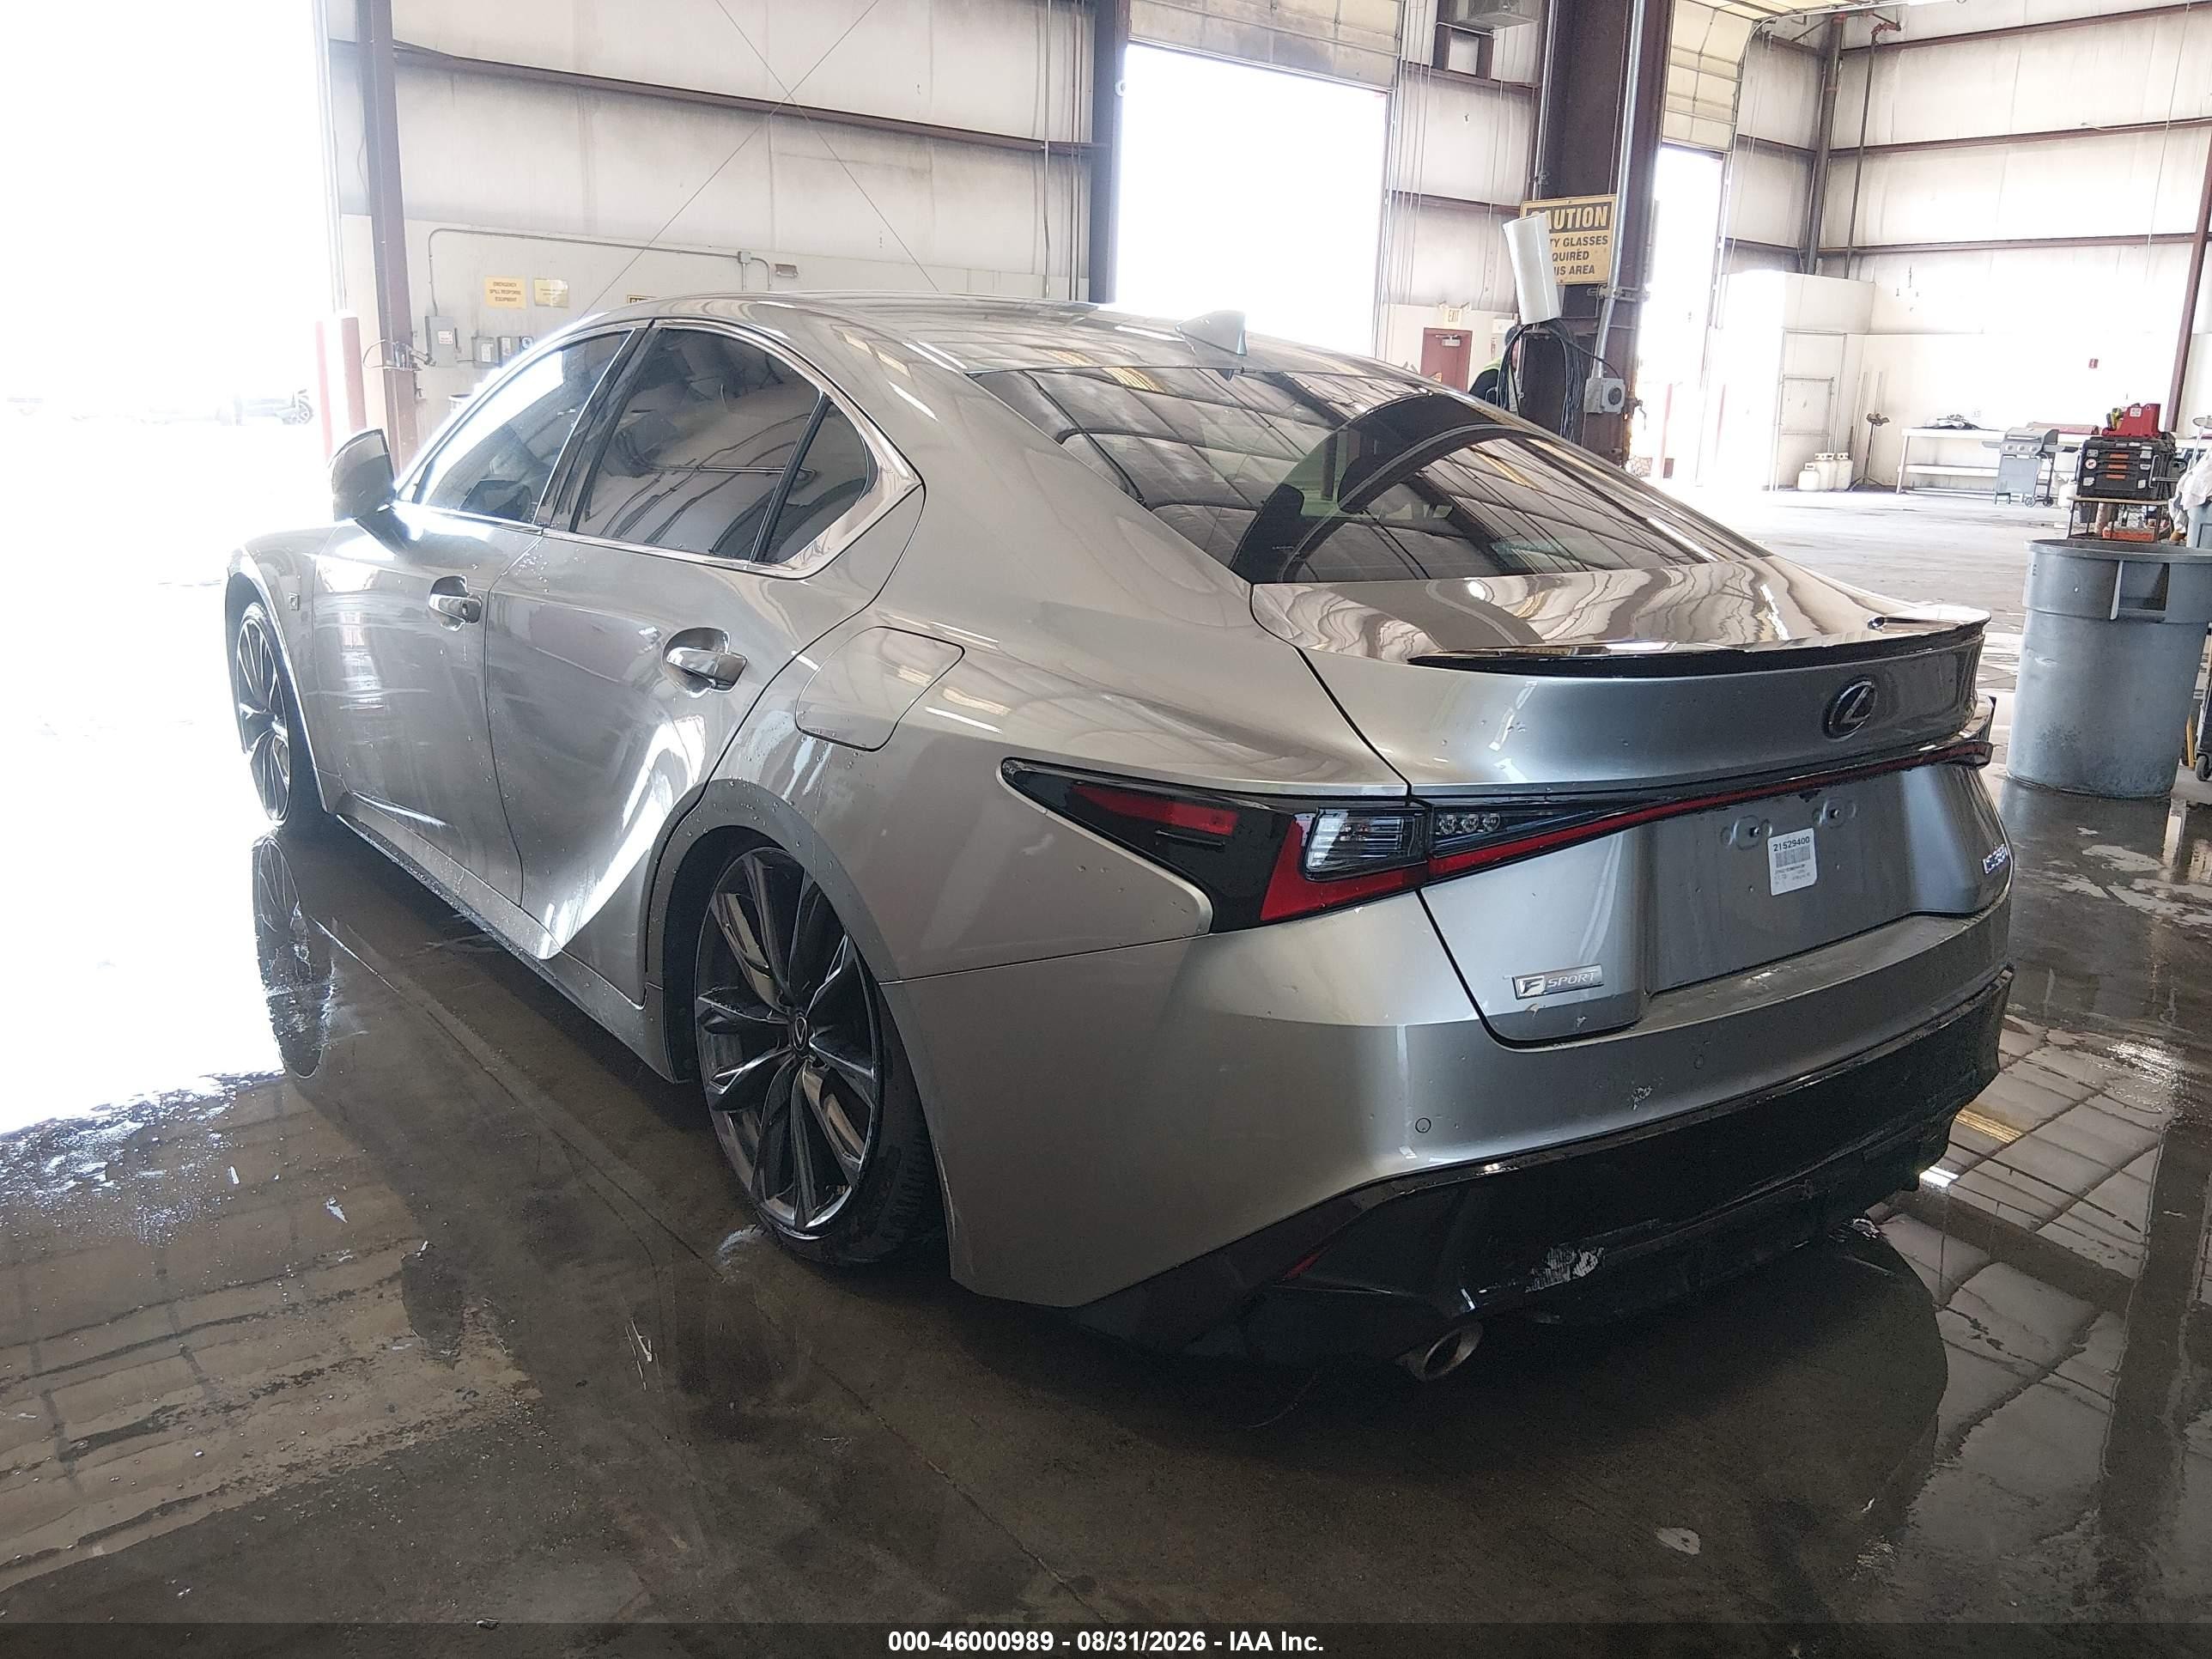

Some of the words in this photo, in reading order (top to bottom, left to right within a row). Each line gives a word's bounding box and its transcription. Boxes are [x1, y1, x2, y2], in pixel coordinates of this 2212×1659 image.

[1532, 205, 1608, 230] AUTION
[1563, 234, 1608, 247] GLASSES
[1552, 251, 1589, 262] QUIRED
[1568, 264, 1595, 275] AREA
[1448, 308, 1460, 323] EXIT
[1772, 836, 1810, 852] 21529400
[1518, 975, 1544, 996] F
[1547, 972, 1595, 988] SPORT
